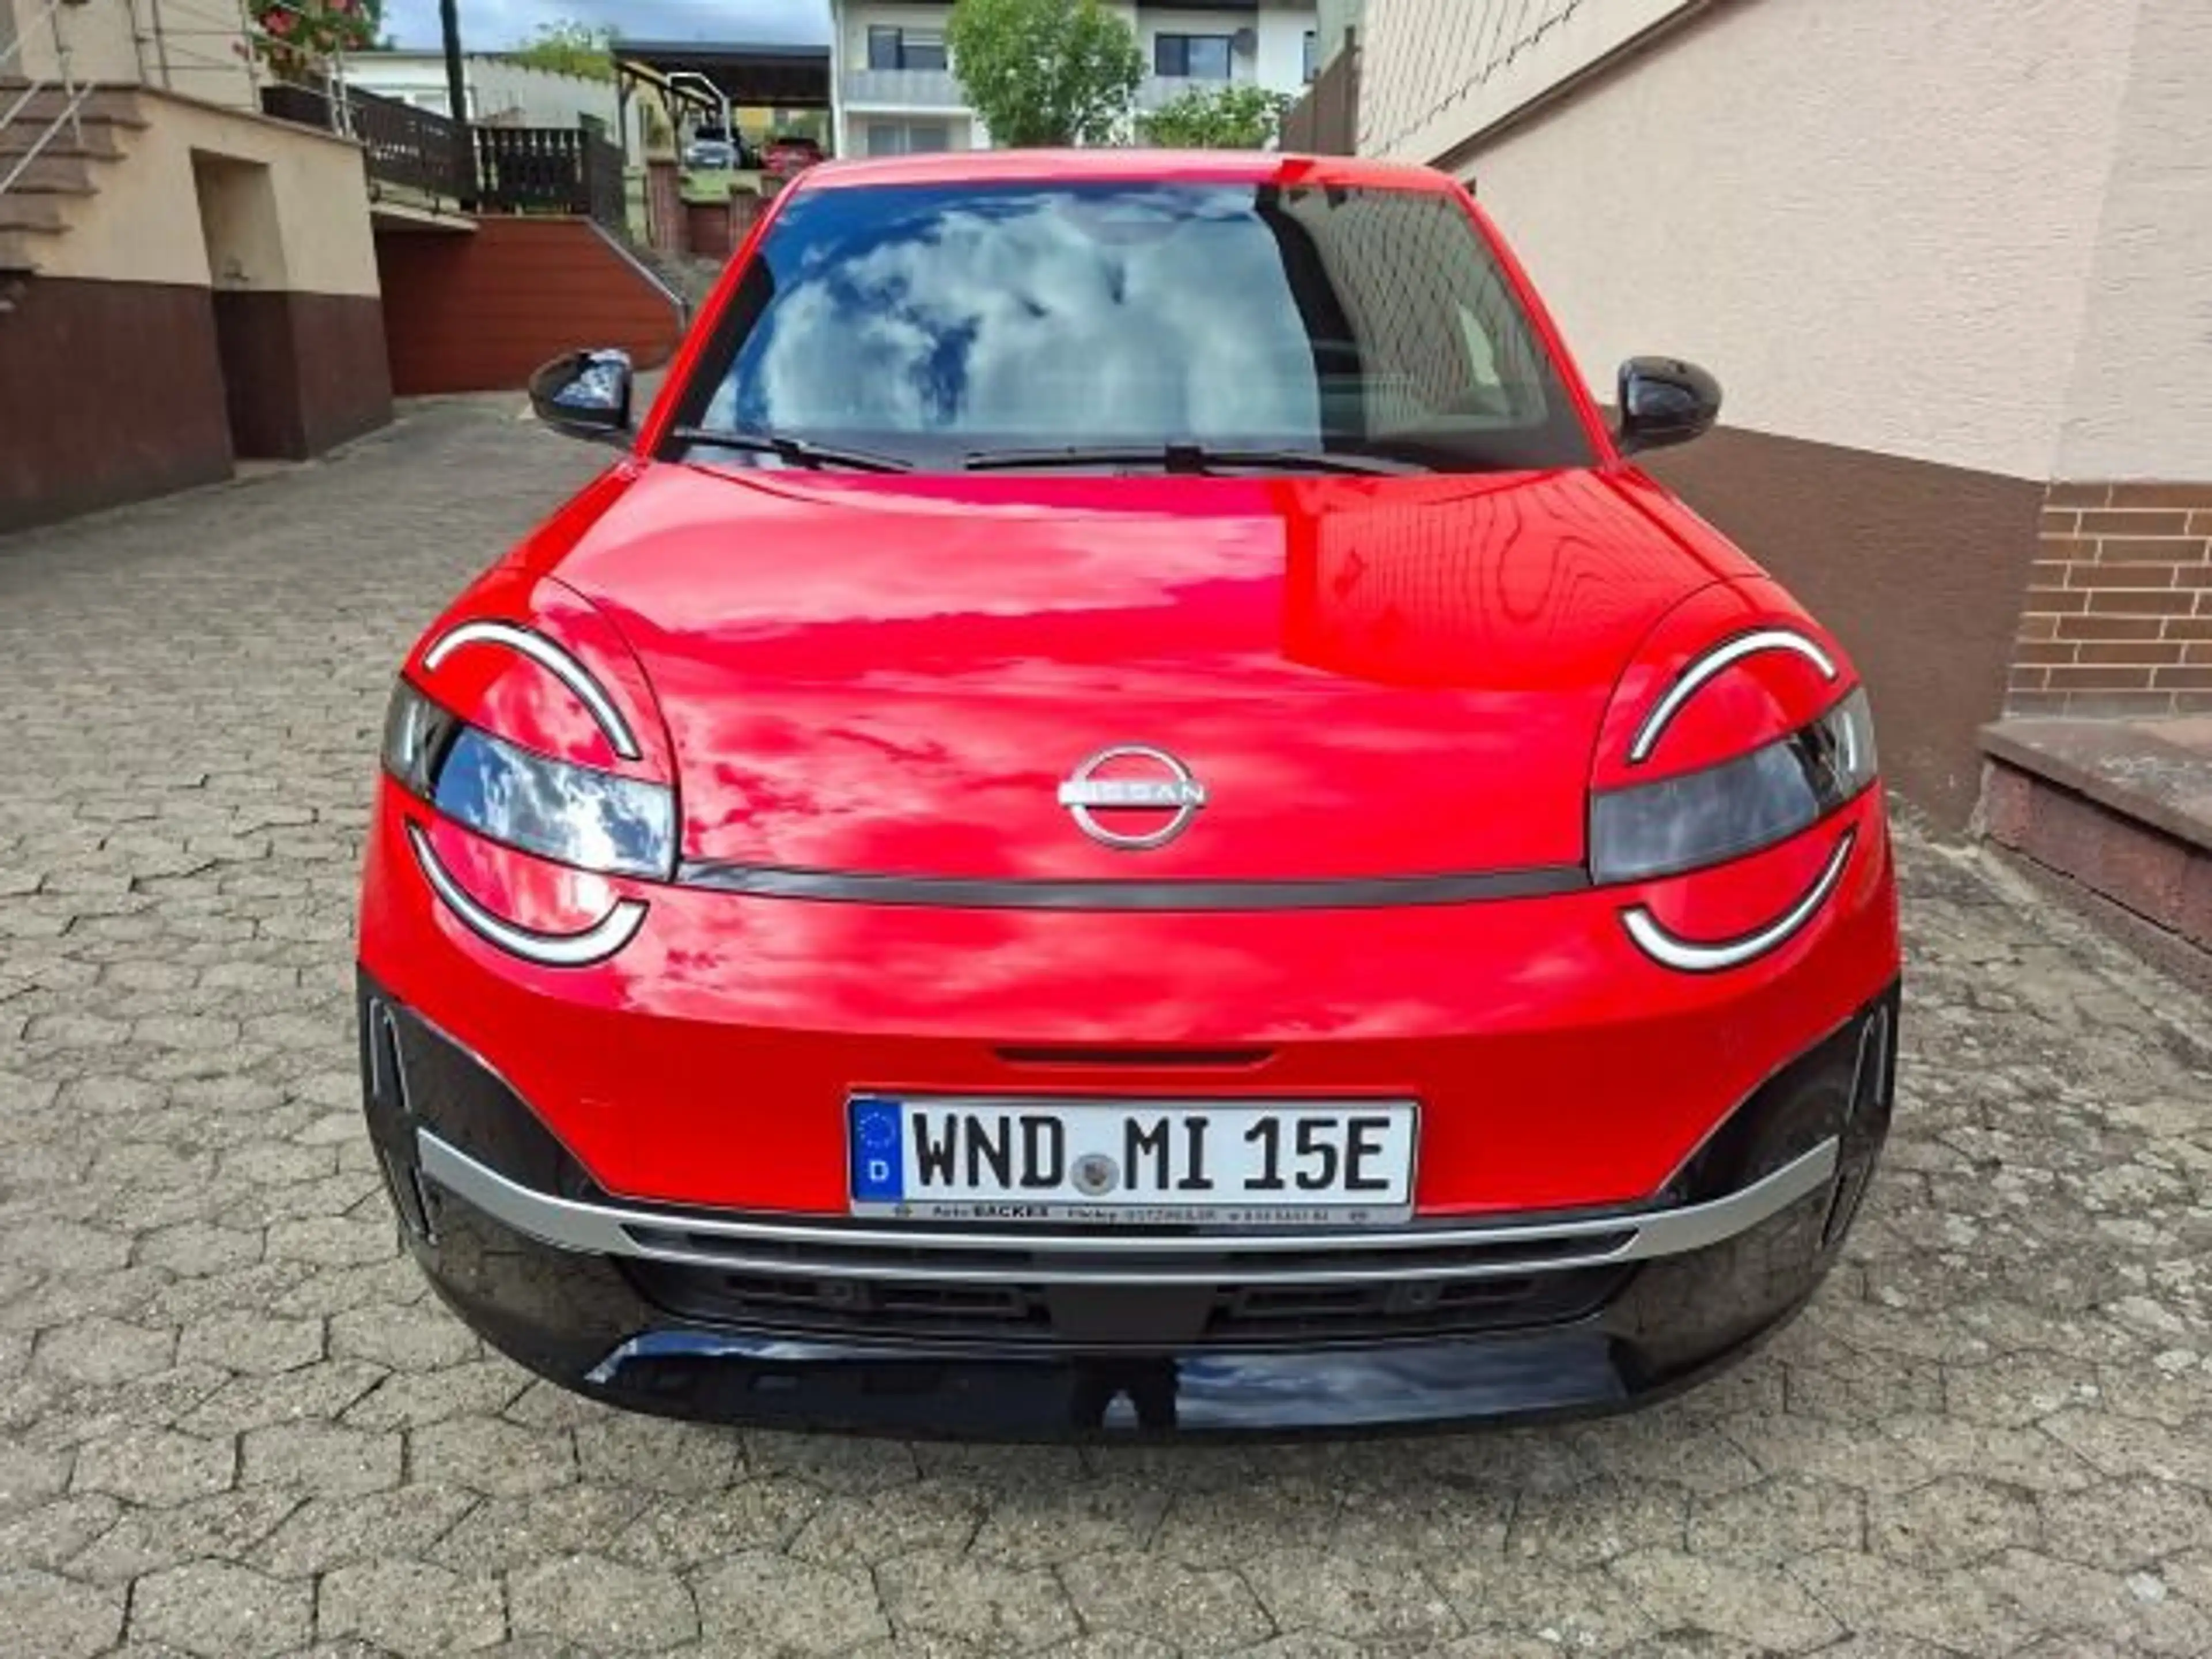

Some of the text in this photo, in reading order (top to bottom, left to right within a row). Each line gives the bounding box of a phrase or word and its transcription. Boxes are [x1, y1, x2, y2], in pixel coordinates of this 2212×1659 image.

[1060, 782, 1205, 803] ISSAN
[912, 1113, 1391, 1190] WND MI 15E
[869, 1160, 889, 1182] D
